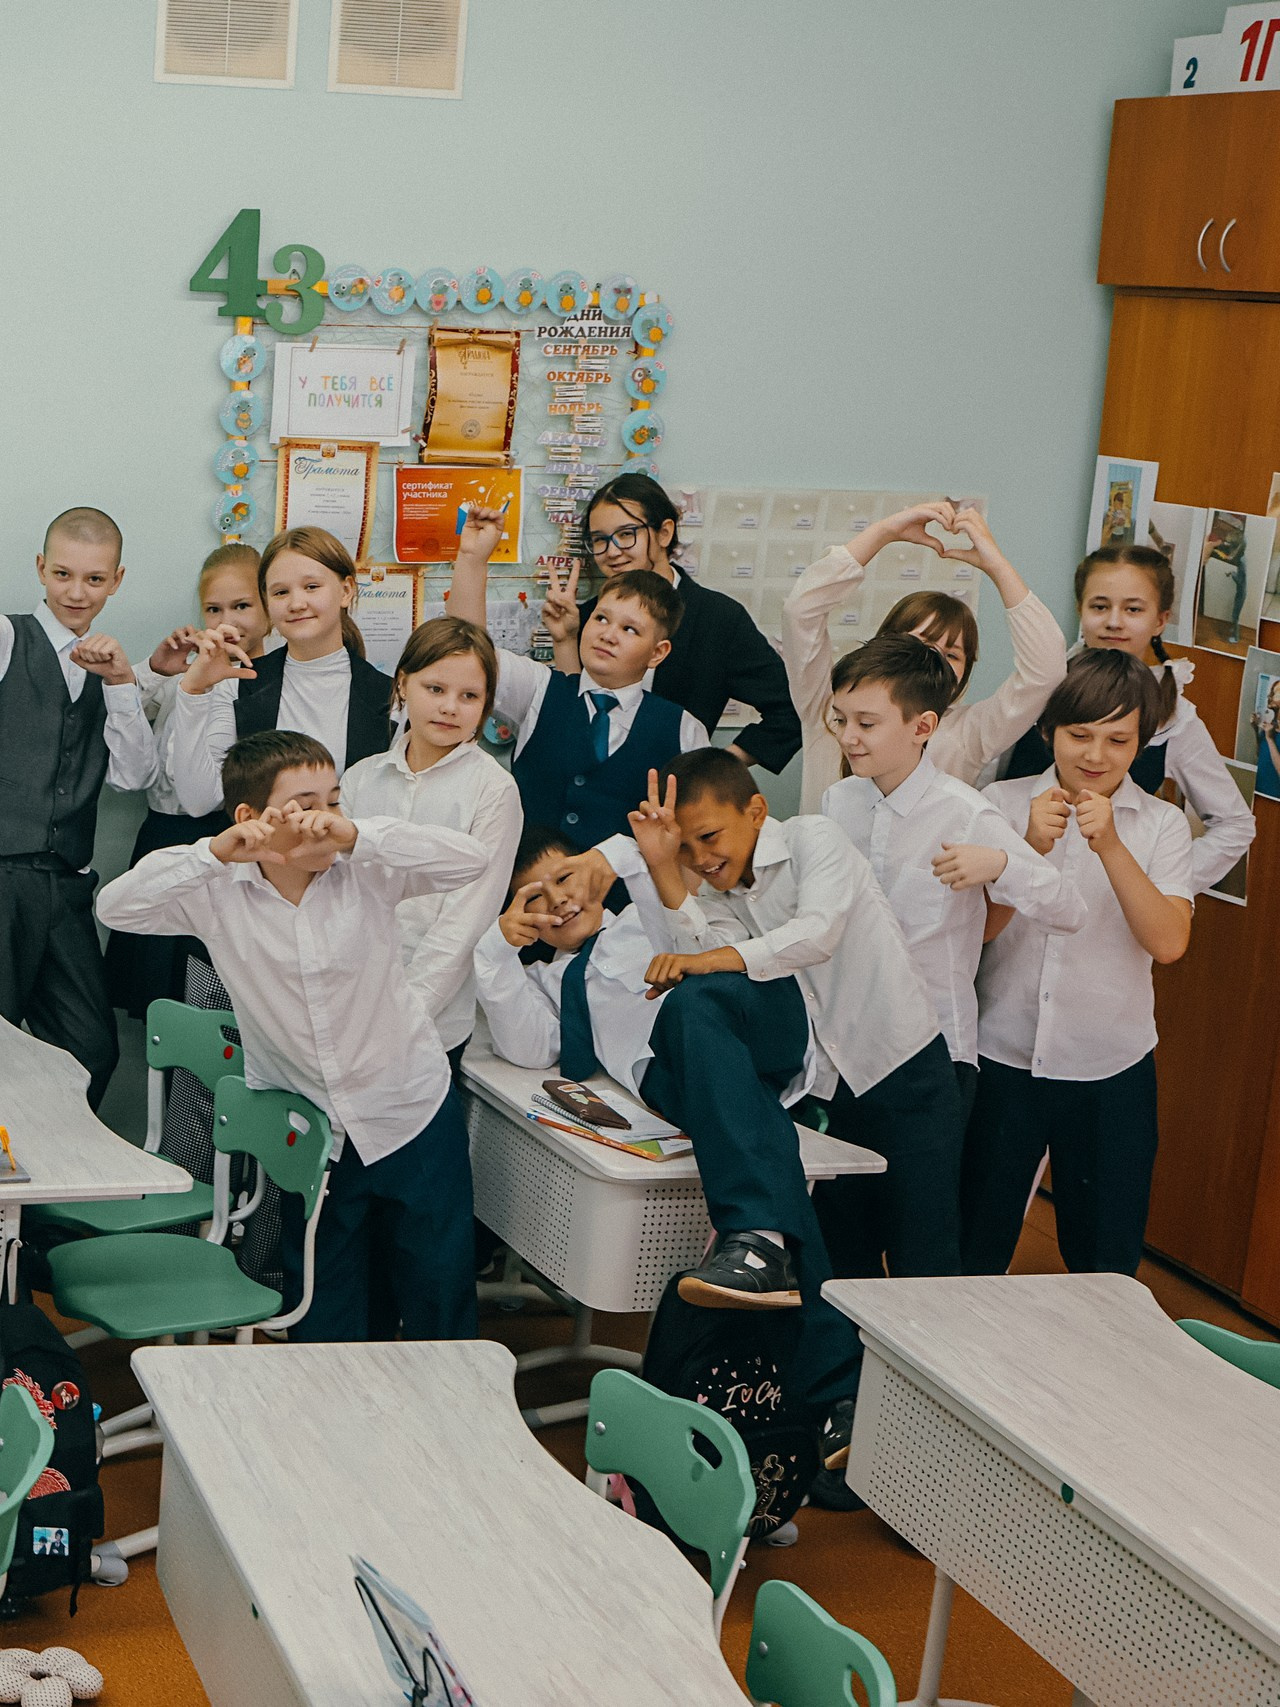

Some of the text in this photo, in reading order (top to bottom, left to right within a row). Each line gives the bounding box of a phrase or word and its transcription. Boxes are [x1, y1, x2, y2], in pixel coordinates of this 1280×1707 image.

[1183, 57, 1198, 89] 2
[536, 326, 632, 339] РОЖДЕНИЯ
[543, 344, 619, 356] СЕНТЯБРЬ
[298, 373, 394, 391] У ТЕБЯ ВСЁ
[546, 371, 612, 383] ОКТЯБРЬ
[308, 393, 383, 408] ПОЛУЧИТСЯ
[548, 403, 603, 415] НОЯБРЬ
[538, 432, 607, 447] ДЕКАБРЬ
[294, 456, 360, 479] Грамота
[545, 463, 600, 476] ЯНВАРЬ
[401, 481, 454, 491] сертификат
[538, 485, 597, 500] ФЕВРАЛ
[402, 491, 448, 500] участника
[548, 512, 582, 523] МАР
